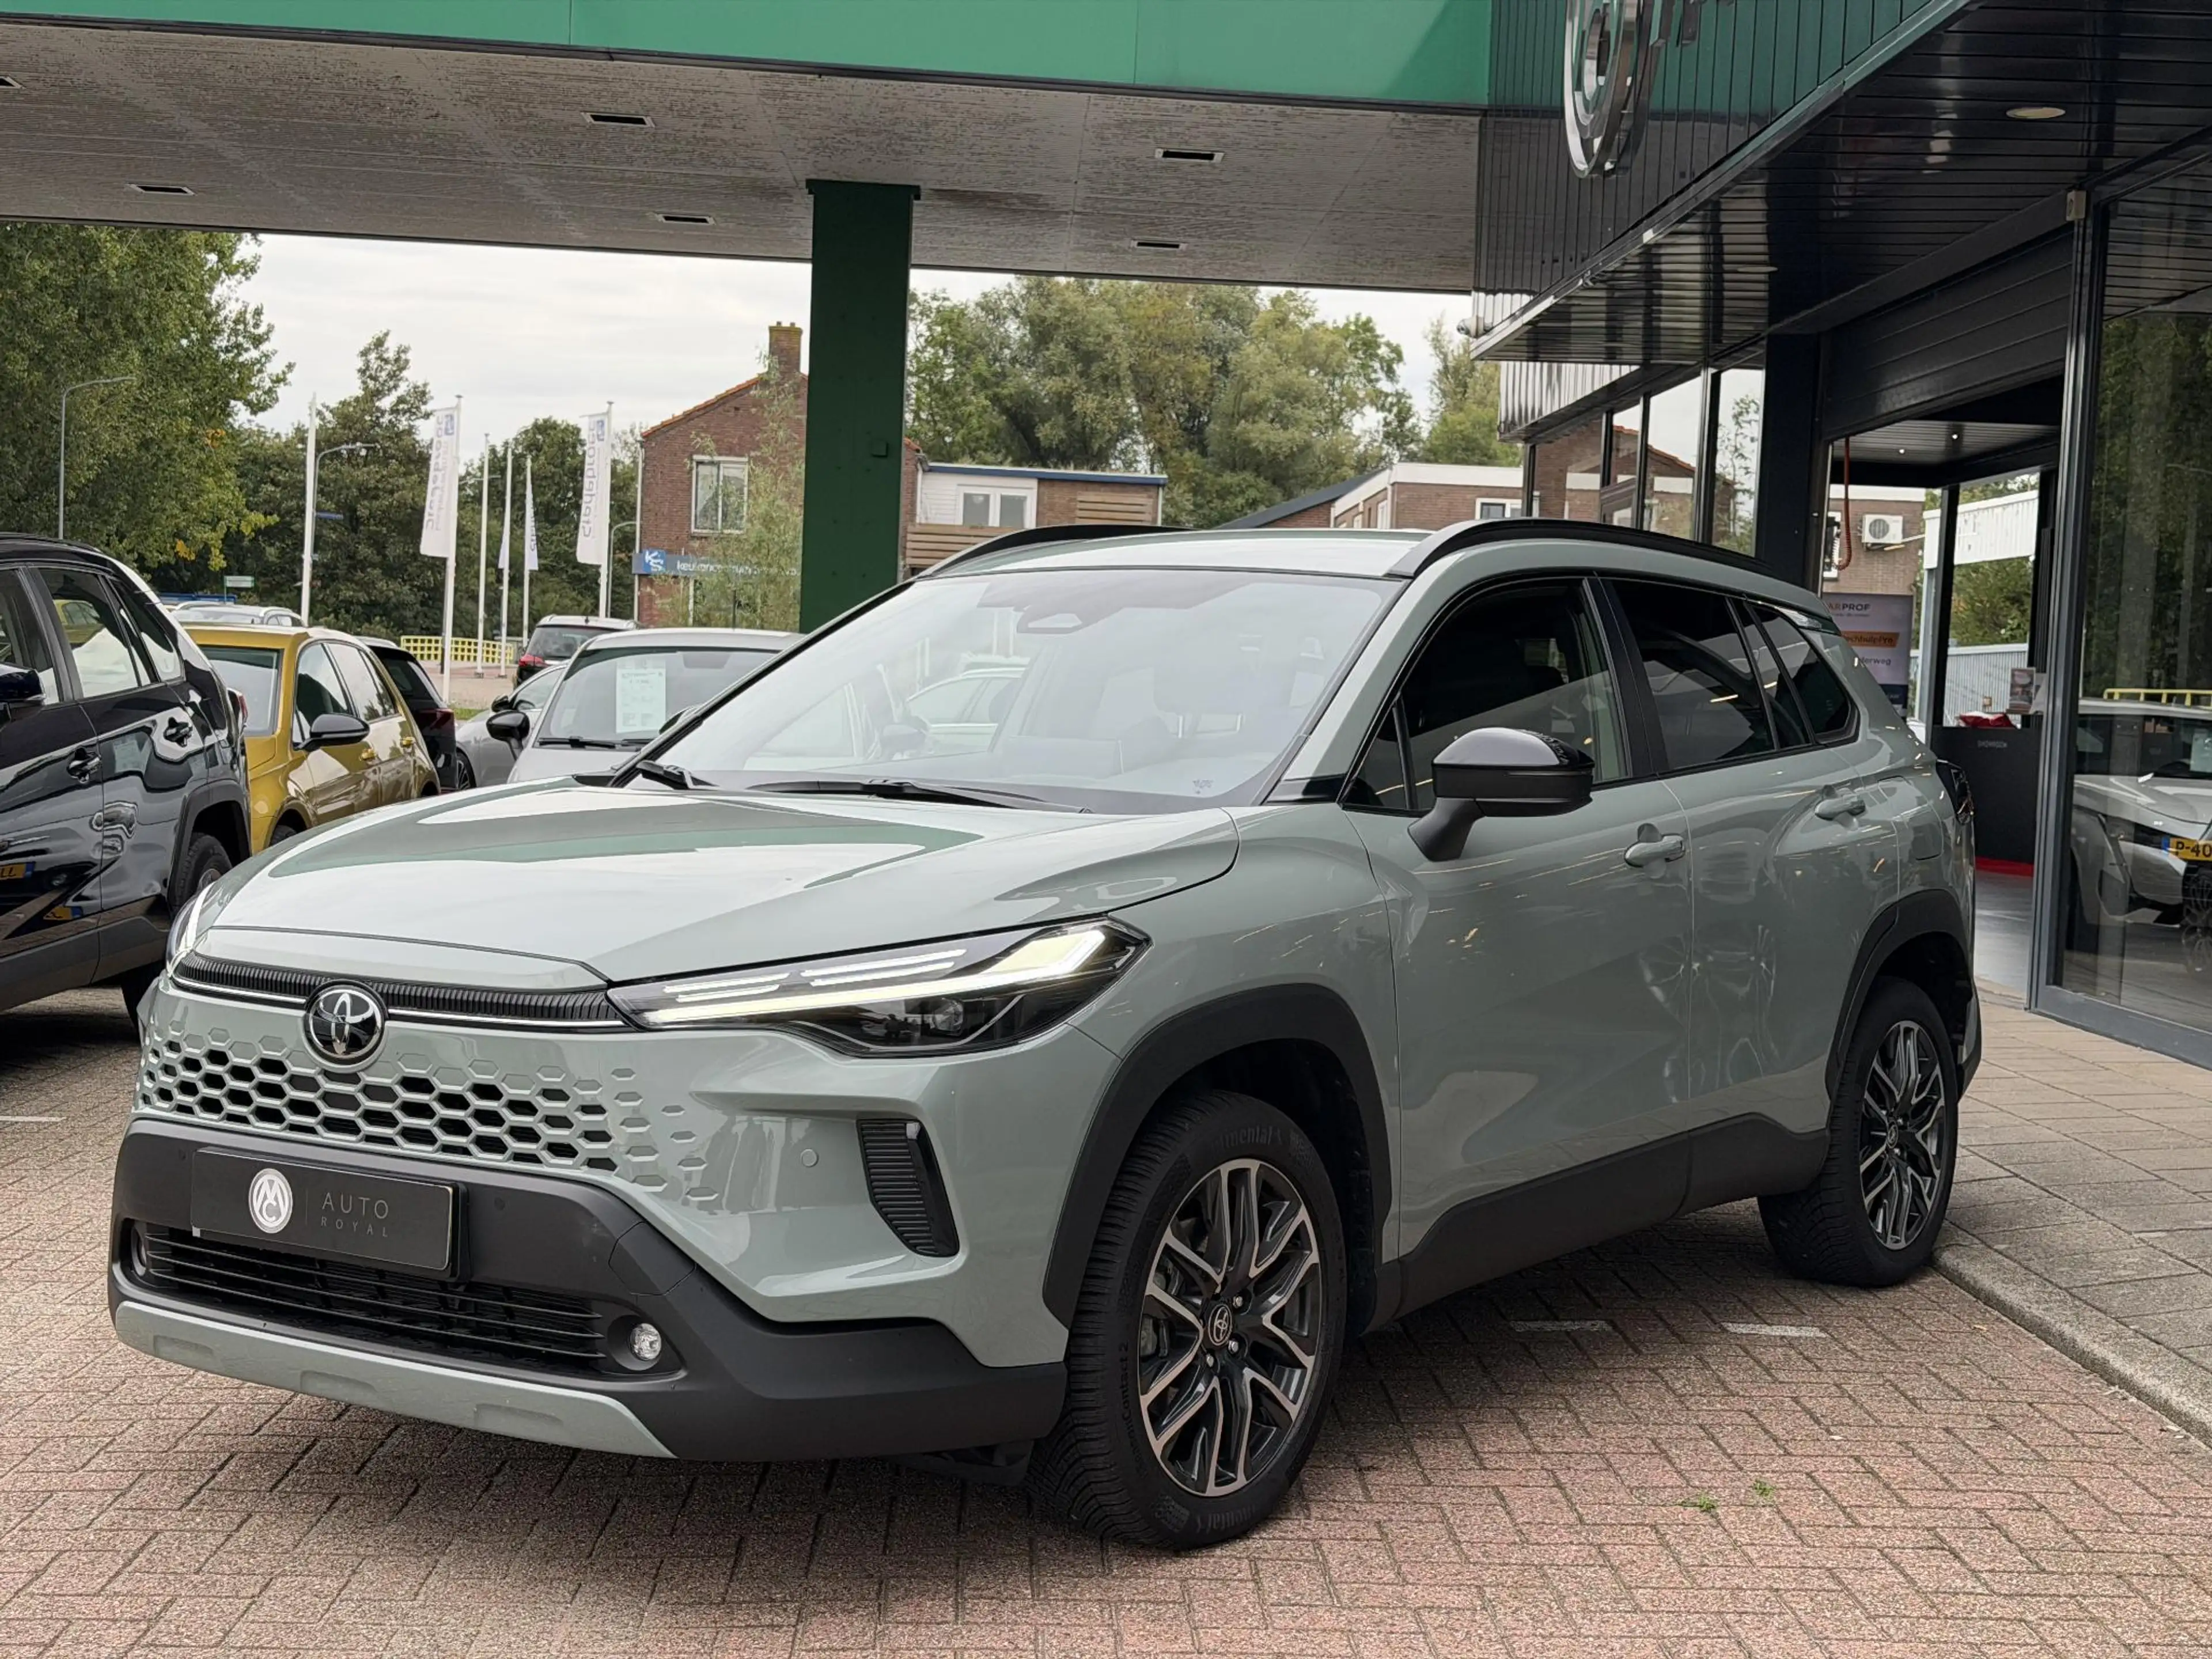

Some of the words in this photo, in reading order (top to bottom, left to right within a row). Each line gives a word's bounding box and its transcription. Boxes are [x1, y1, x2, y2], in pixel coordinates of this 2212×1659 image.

[1827, 603, 1871, 611] ARPROF
[321, 1192, 389, 1219] AUTO
[320, 1216, 388, 1237] ROYAL
